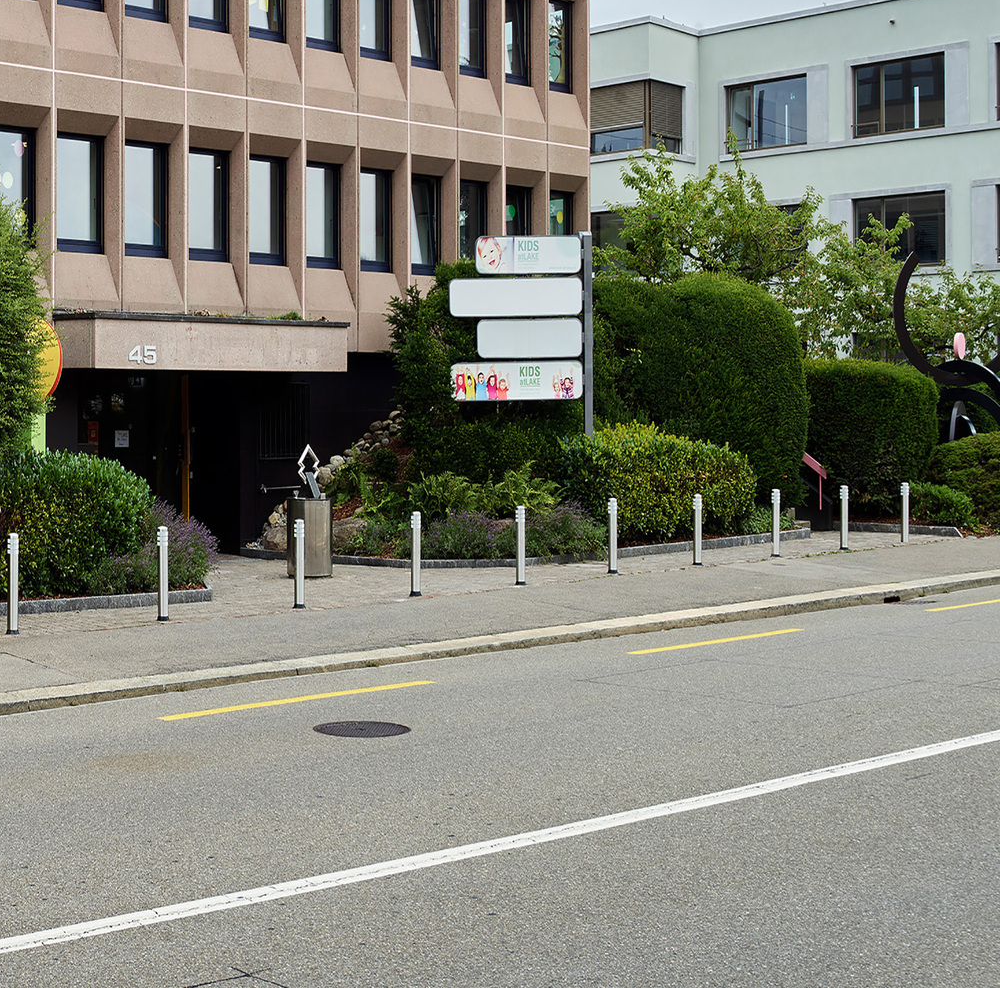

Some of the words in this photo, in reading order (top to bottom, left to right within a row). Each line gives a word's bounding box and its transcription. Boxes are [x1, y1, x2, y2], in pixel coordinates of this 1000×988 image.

[517, 240, 540, 252] KIDS
[128, 345, 157, 365] 45
[519, 365, 541, 377] KIDS
